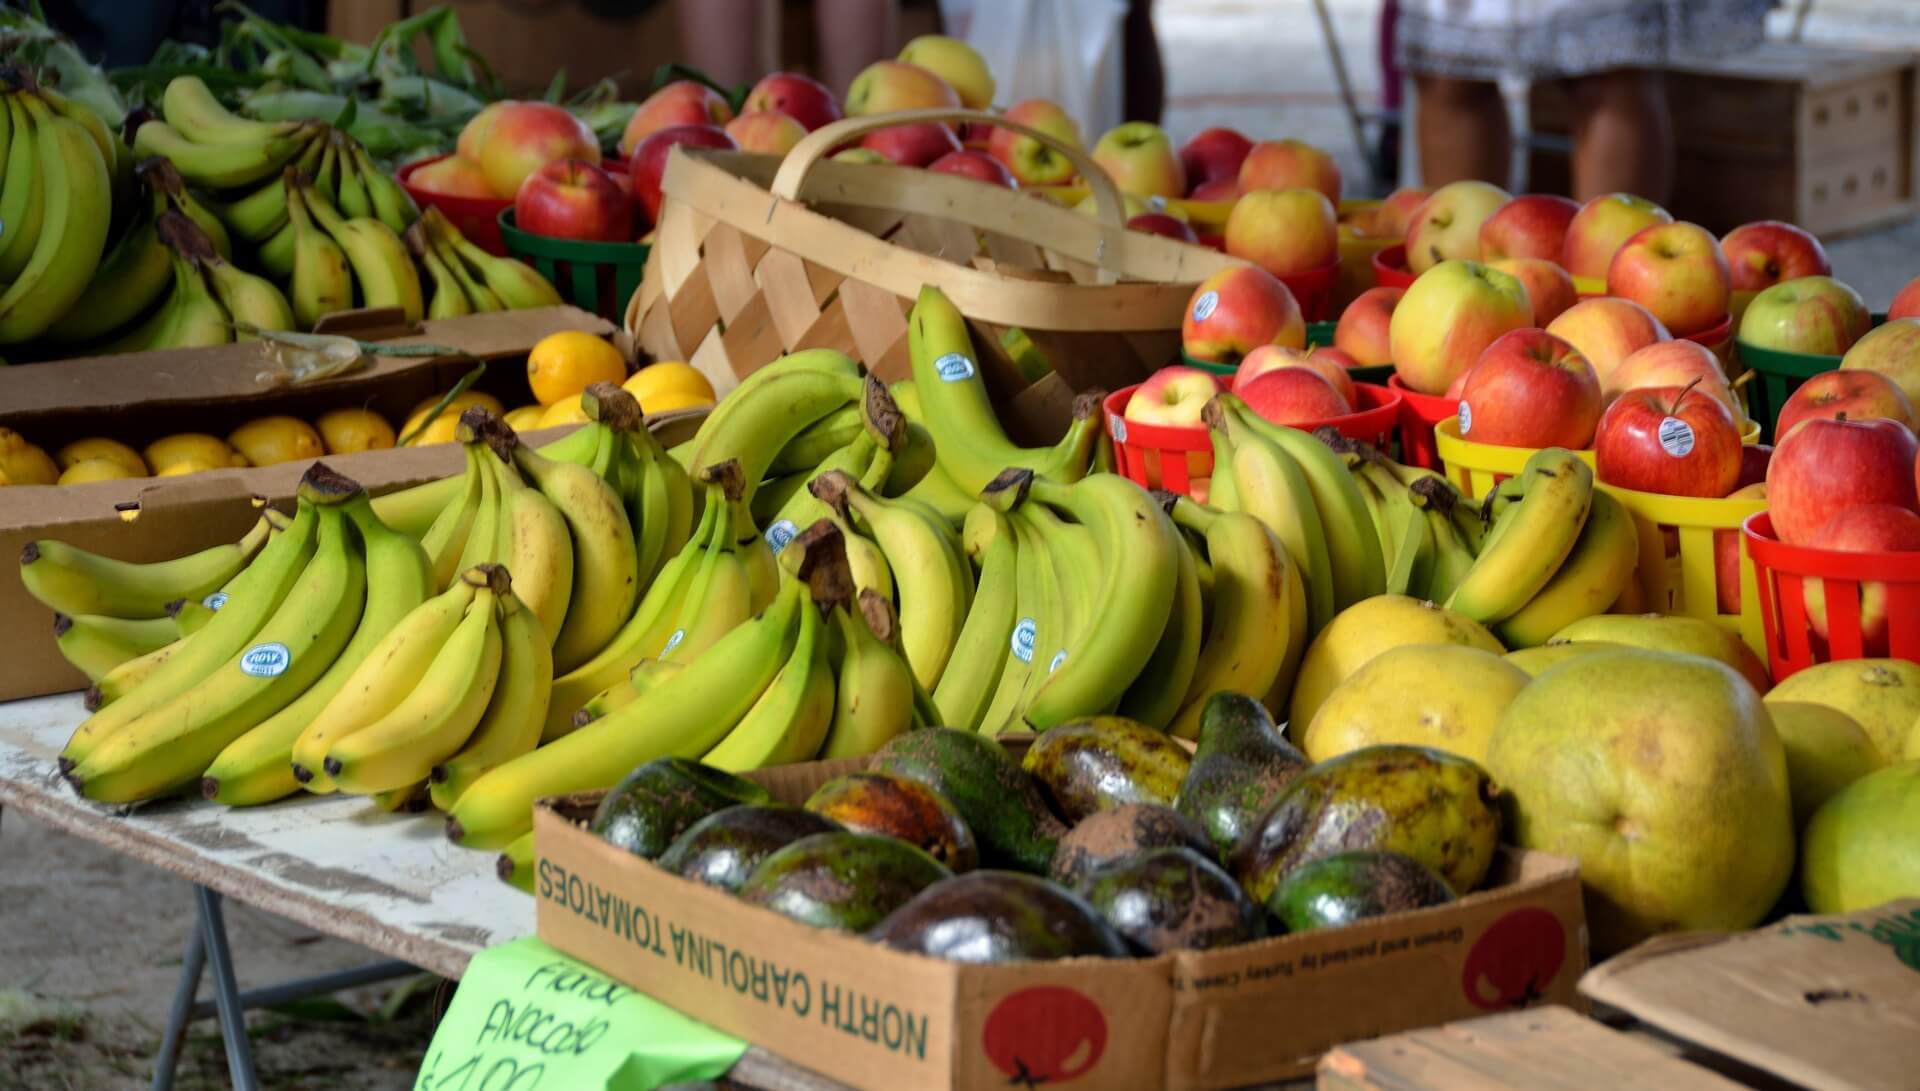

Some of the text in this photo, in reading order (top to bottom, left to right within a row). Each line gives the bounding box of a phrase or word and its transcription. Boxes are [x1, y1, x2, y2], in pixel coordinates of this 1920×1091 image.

[1381, 937, 1409, 956] and
[1414, 926, 1464, 948] Grown
[538, 857, 928, 1061] NORTH CAROLINA TOMATOES
[1301, 952, 1317, 969] by
[1321, 939, 1377, 968] packed
[1247, 961, 1293, 980] Turkey
